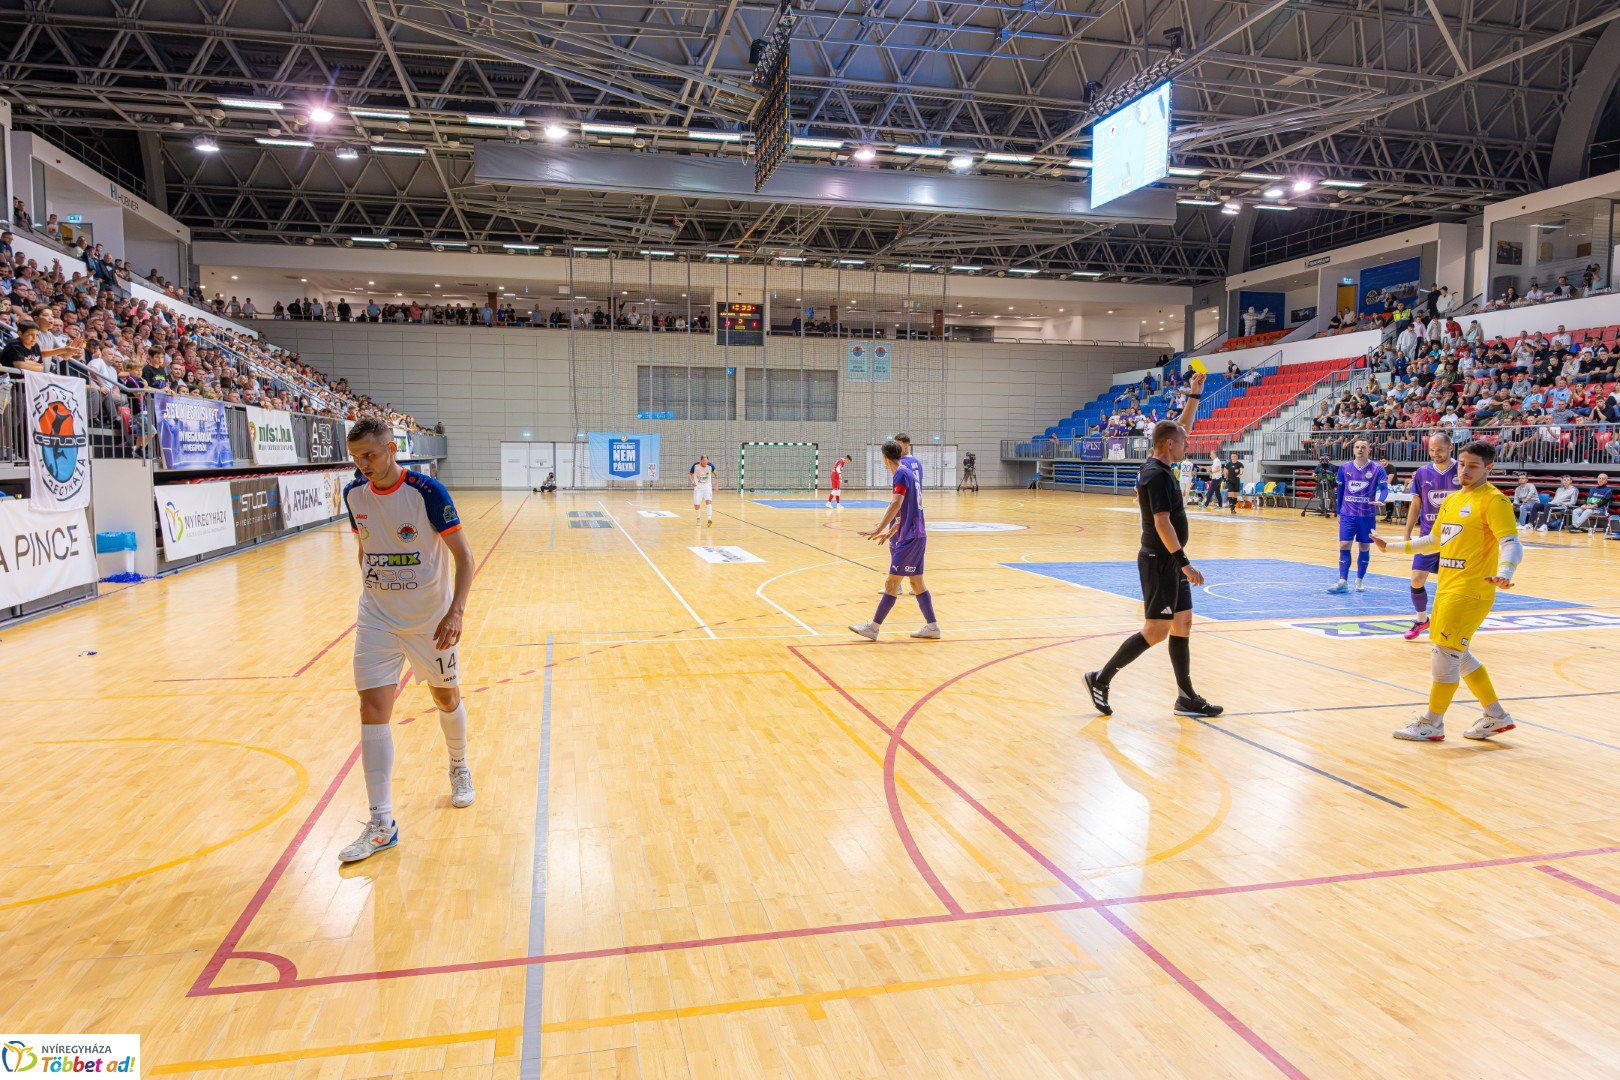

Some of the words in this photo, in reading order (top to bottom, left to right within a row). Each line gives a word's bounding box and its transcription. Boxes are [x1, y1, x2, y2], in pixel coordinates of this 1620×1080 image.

[613, 450, 635, 461] NEM
[1181, 464, 1191, 472] 20
[16, 525, 79, 571] PINCE
[364, 580, 418, 591] STUDIO
[435, 652, 456, 675] 14
